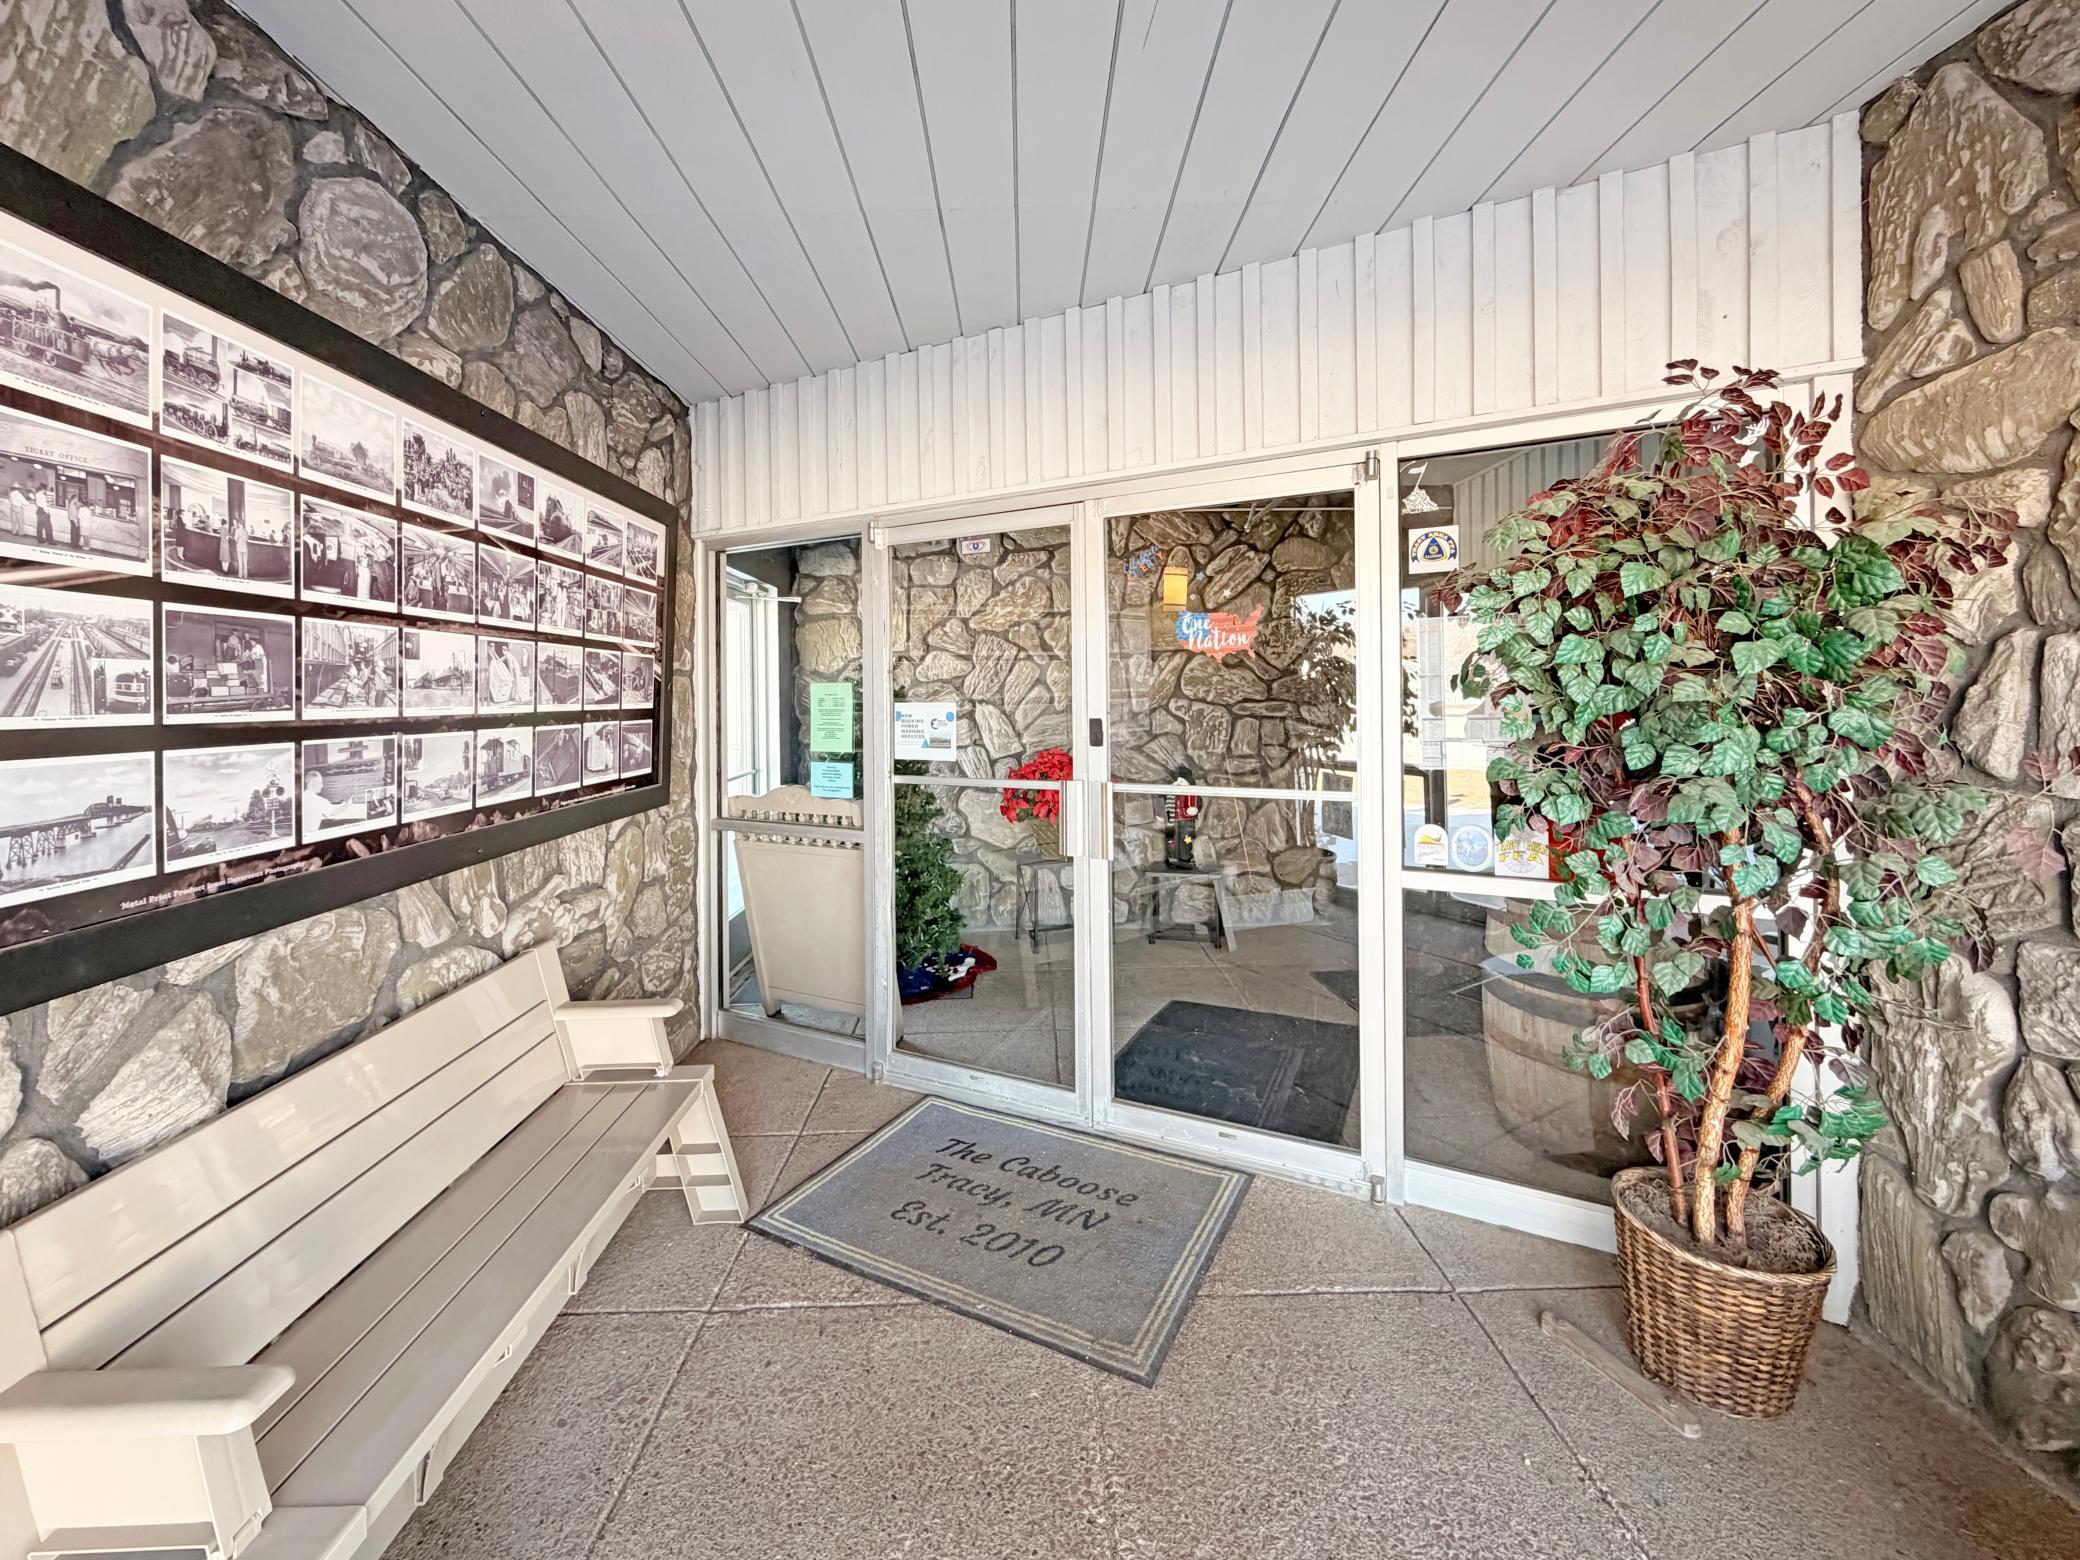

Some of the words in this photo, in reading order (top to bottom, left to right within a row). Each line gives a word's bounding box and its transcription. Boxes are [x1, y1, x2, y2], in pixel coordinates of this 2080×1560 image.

[25, 446, 54, 458] TICKET
[58, 452, 89, 464] OFFICE
[1182, 612, 1212, 634] One
[1188, 626, 1251, 650] Nation
[120, 897, 147, 910] Metal
[149, 892, 171, 904] Print
[173, 884, 205, 898] Product
[936, 1138, 992, 1164] The
[999, 1157, 1138, 1207] Caboose
[915, 1163, 1012, 1207] Tracy,
[1023, 1199, 1110, 1230] MN
[890, 1200, 950, 1235] Est.
[959, 1223, 1066, 1267] 2010
